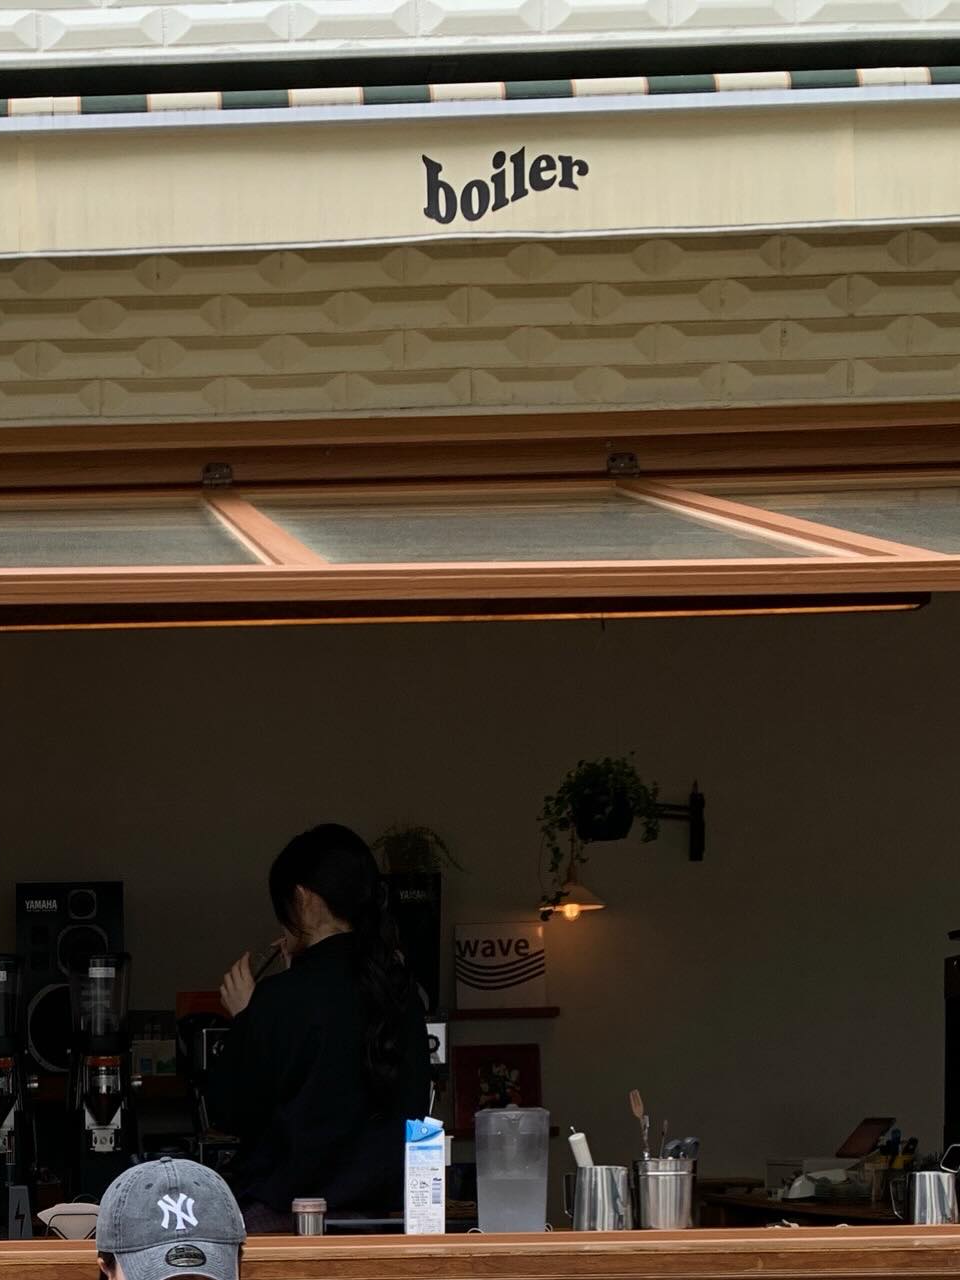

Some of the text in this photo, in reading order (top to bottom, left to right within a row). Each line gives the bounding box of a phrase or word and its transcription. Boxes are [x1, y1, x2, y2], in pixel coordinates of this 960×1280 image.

[422, 146, 589, 224] boiler
[24, 899, 57, 909] YAMAHA
[456, 939, 529, 957] wave
[157, 1193, 199, 1230] NY
